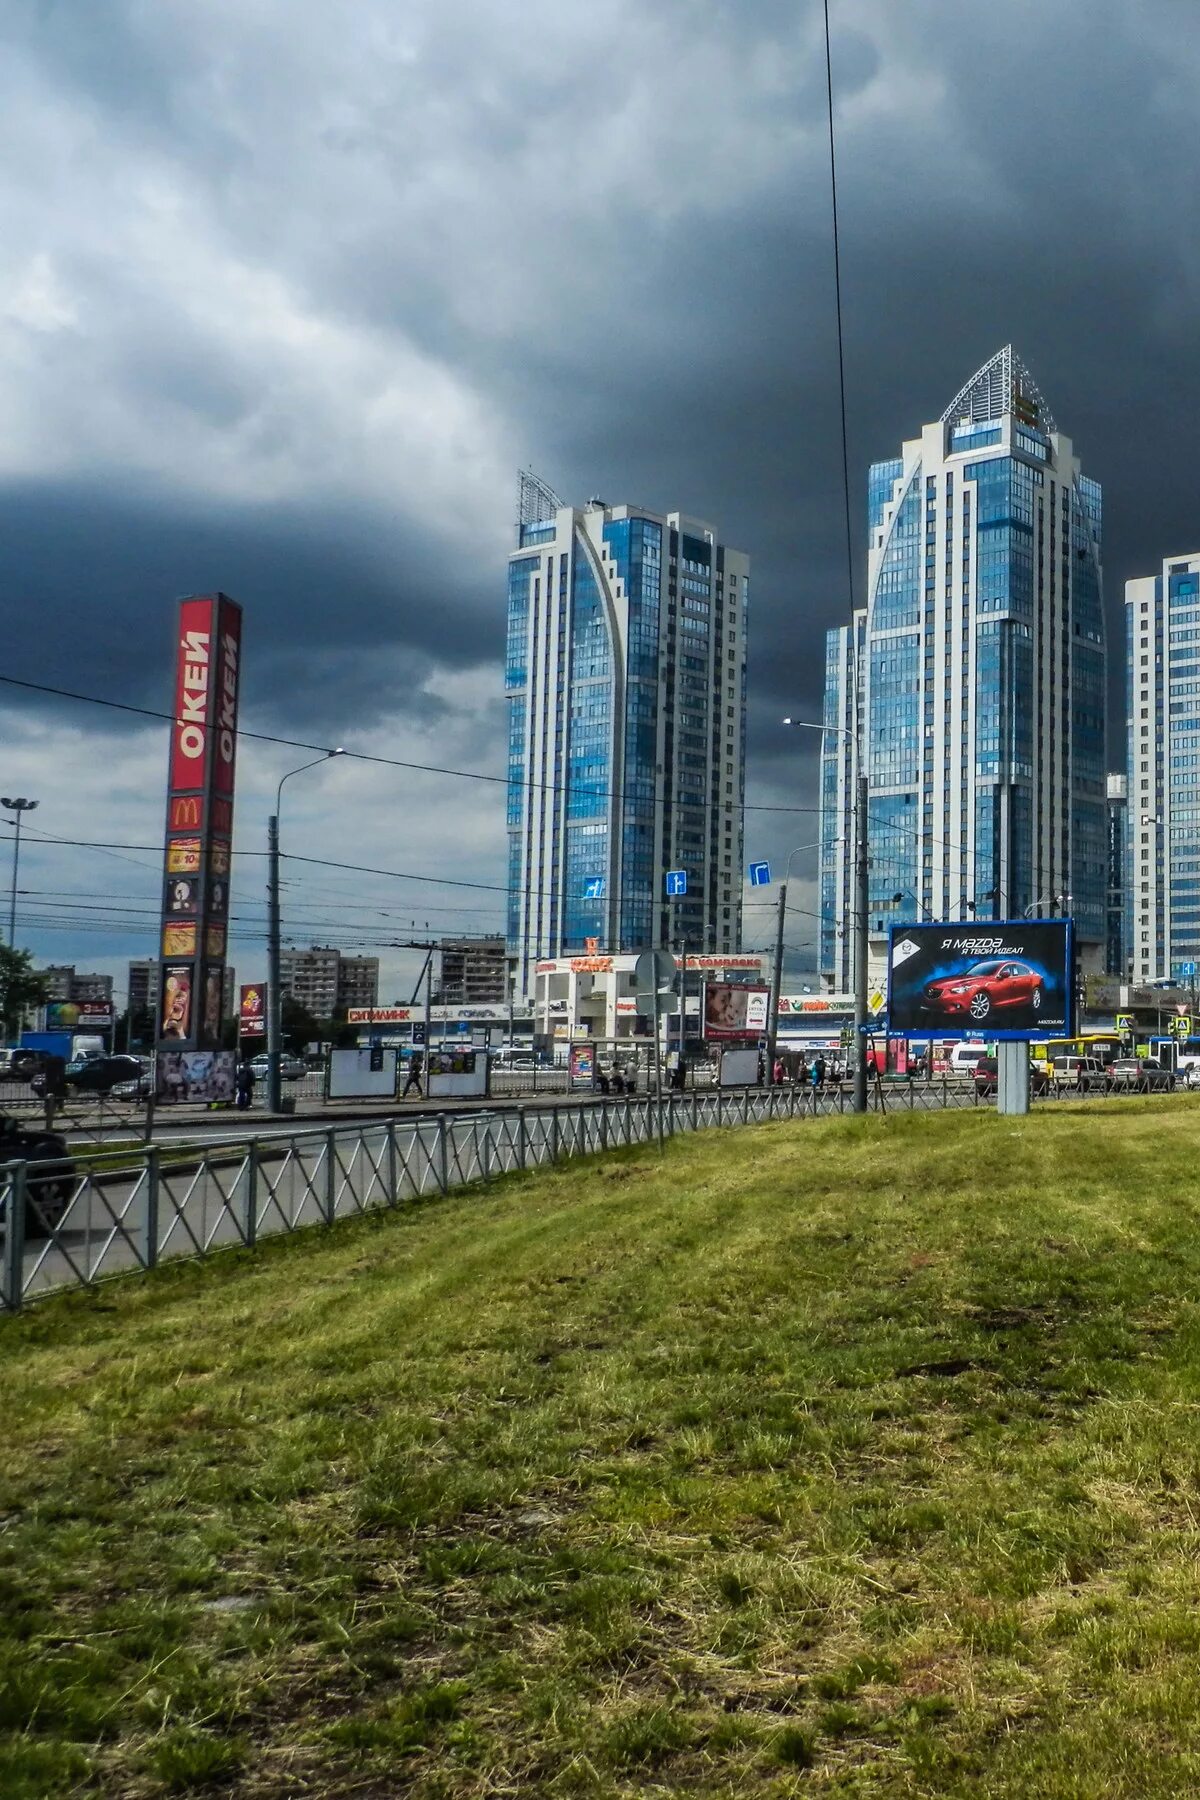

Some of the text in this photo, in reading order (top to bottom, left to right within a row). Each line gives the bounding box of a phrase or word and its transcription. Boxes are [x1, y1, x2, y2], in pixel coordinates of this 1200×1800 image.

[940, 938, 952, 949] Я
[970, 947, 993, 955] ТВОЙ
[994, 947, 1024, 955] ИДЕАЛ
